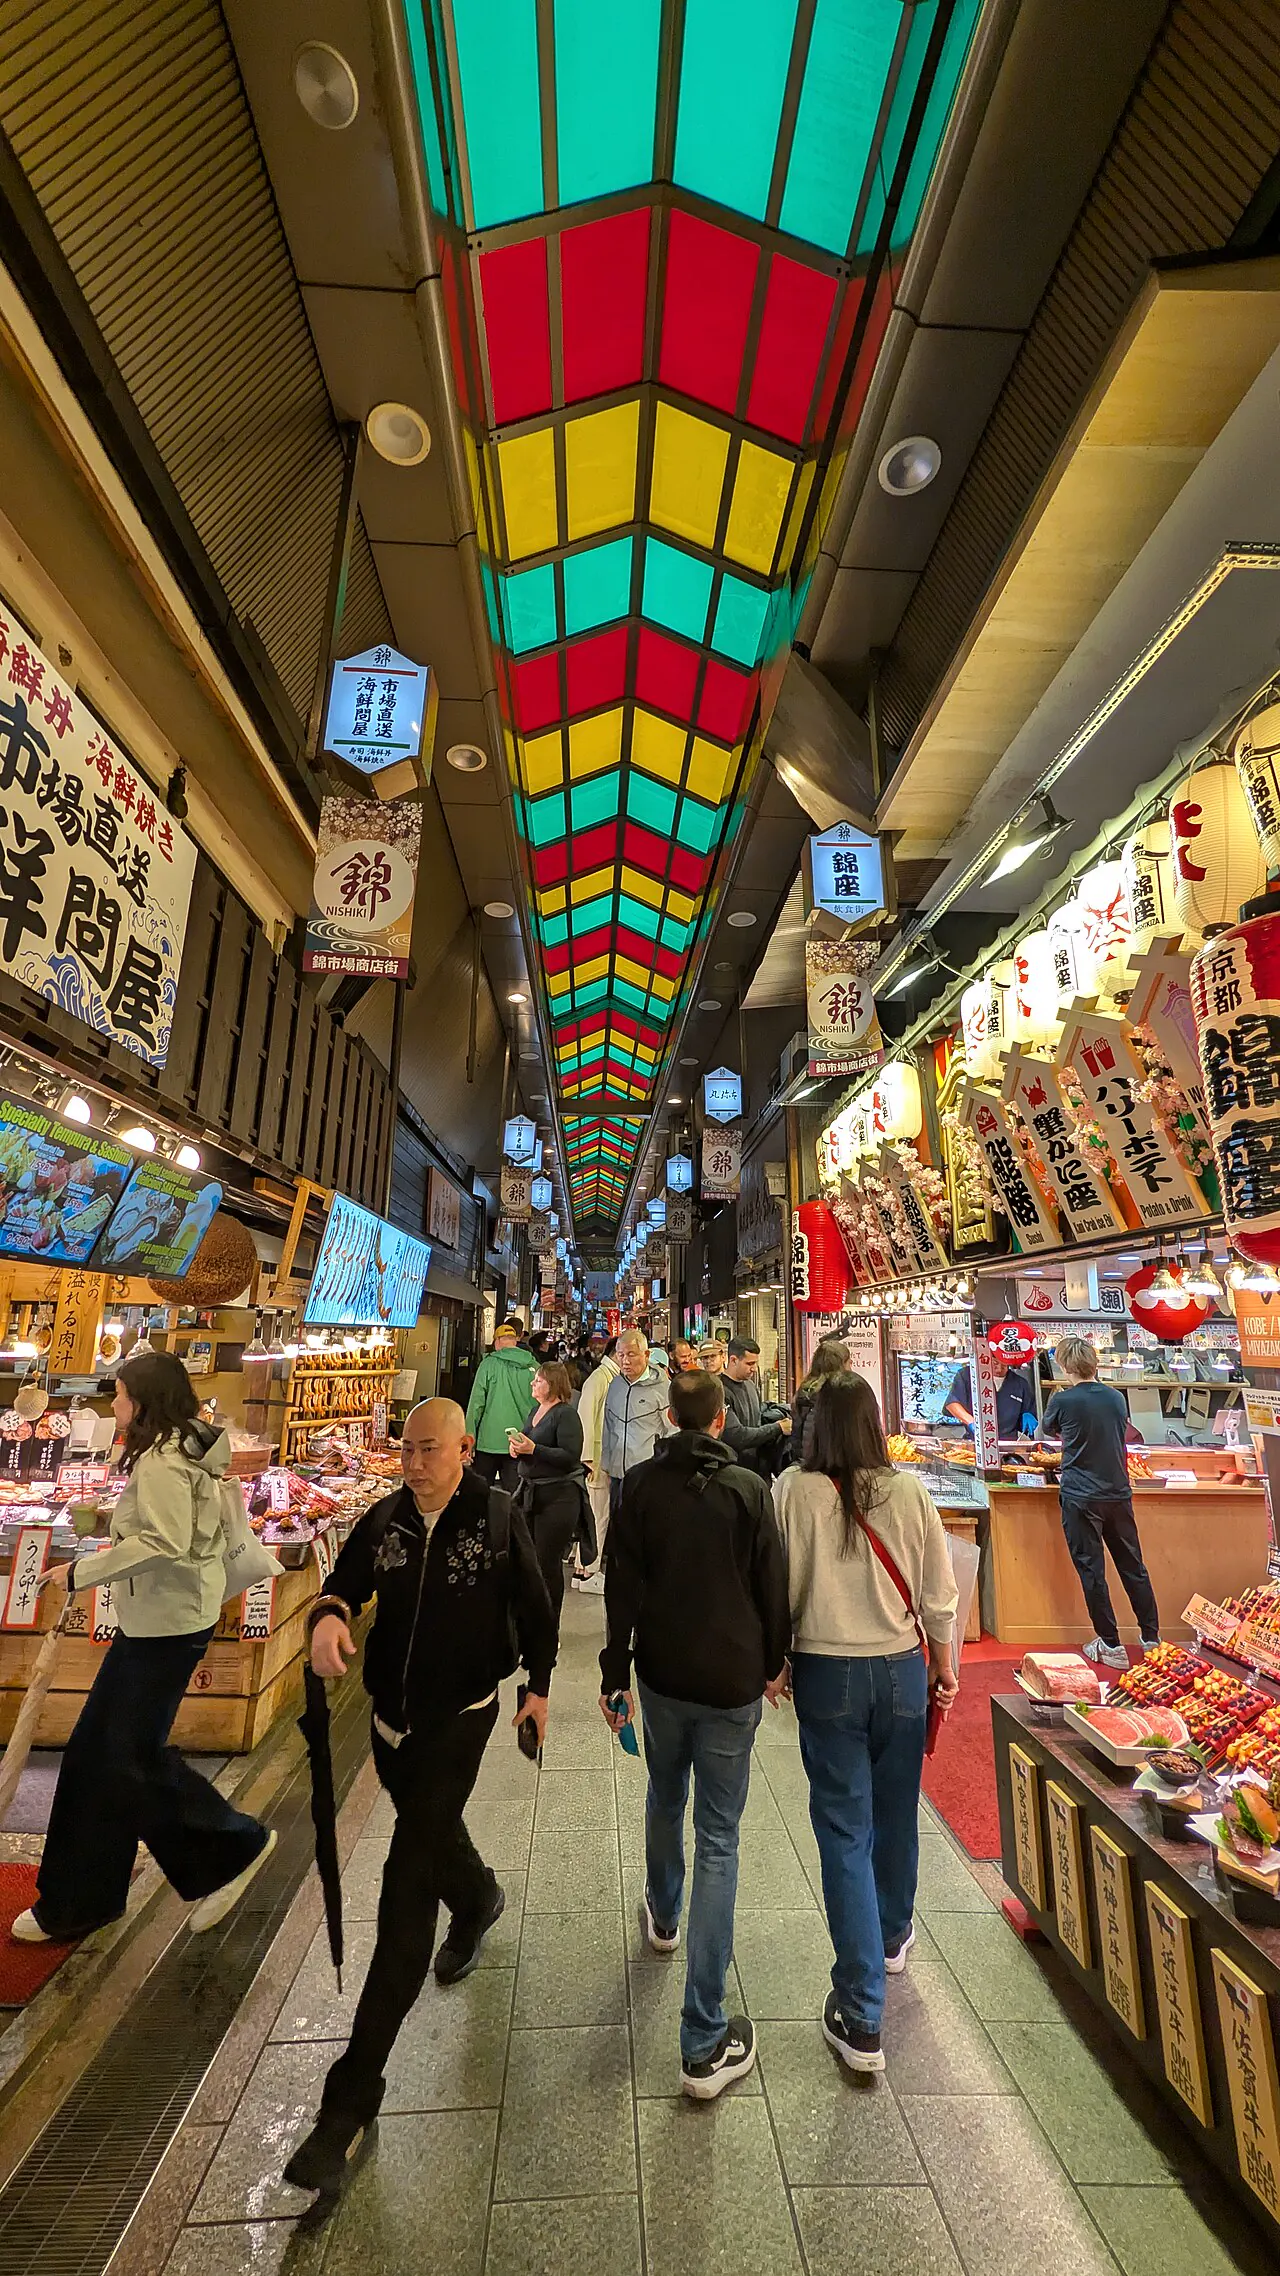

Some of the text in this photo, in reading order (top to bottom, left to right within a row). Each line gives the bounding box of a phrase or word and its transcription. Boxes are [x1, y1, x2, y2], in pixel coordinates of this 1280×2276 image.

[352, 677, 377, 736] 海鮮問屋
[375, 679, 399, 738] 市場直送
[85, 732, 174, 863] 海鮮焼き
[330, 851, 391, 921] 錦
[832, 852, 861, 897] 錦座
[325, 906, 367, 918] NISHIKI
[834, 905, 864, 914] 飲食街
[312, 954, 399, 974] 錦市場商店街
[1211, 947, 1242, 1017] 京都
[819, 981, 863, 1034] 錦
[820, 1025, 849, 1033] NISHIKI
[815, 1054, 878, 1073] 錦市場商店街
[0, 1101, 51, 1137] Specialty
[50, 1121, 91, 1151] Tempura
[90, 1140, 99, 1153] &
[99, 1141, 133, 1166] Sashimi
[1032, 1107, 1101, 1212] 蟹かに座
[1096, 1077, 1173, 1193] ハリーポテト
[1141, 1203, 1164, 1219] Potato
[1170, 1195, 1194, 1213] Drink
[1026, 1231, 1045, 1245] Sushi
[54, 1271, 87, 1371] 溢れる肉汁
[1244, 1316, 1268, 1335] KOBE
[979, 1353, 998, 1466] 旬の食材盛沢山
[1057, 1827, 1072, 1904] 松阪牛
[1103, 1880, 1123, 1968] 神戸牛
[1108, 1964, 1130, 1998] KOBE
[1110, 1983, 1132, 2023] BEEF
[1161, 1944, 1187, 2045] 近江牛
[1171, 2041, 1191, 2083] OMI
[1171, 2058, 1196, 2104] BEEF
[1231, 2016, 1265, 2140] 佐賀牛
[1242, 2130, 1276, 2189] SAGA
[1247, 2154, 1278, 2212] BEEF
